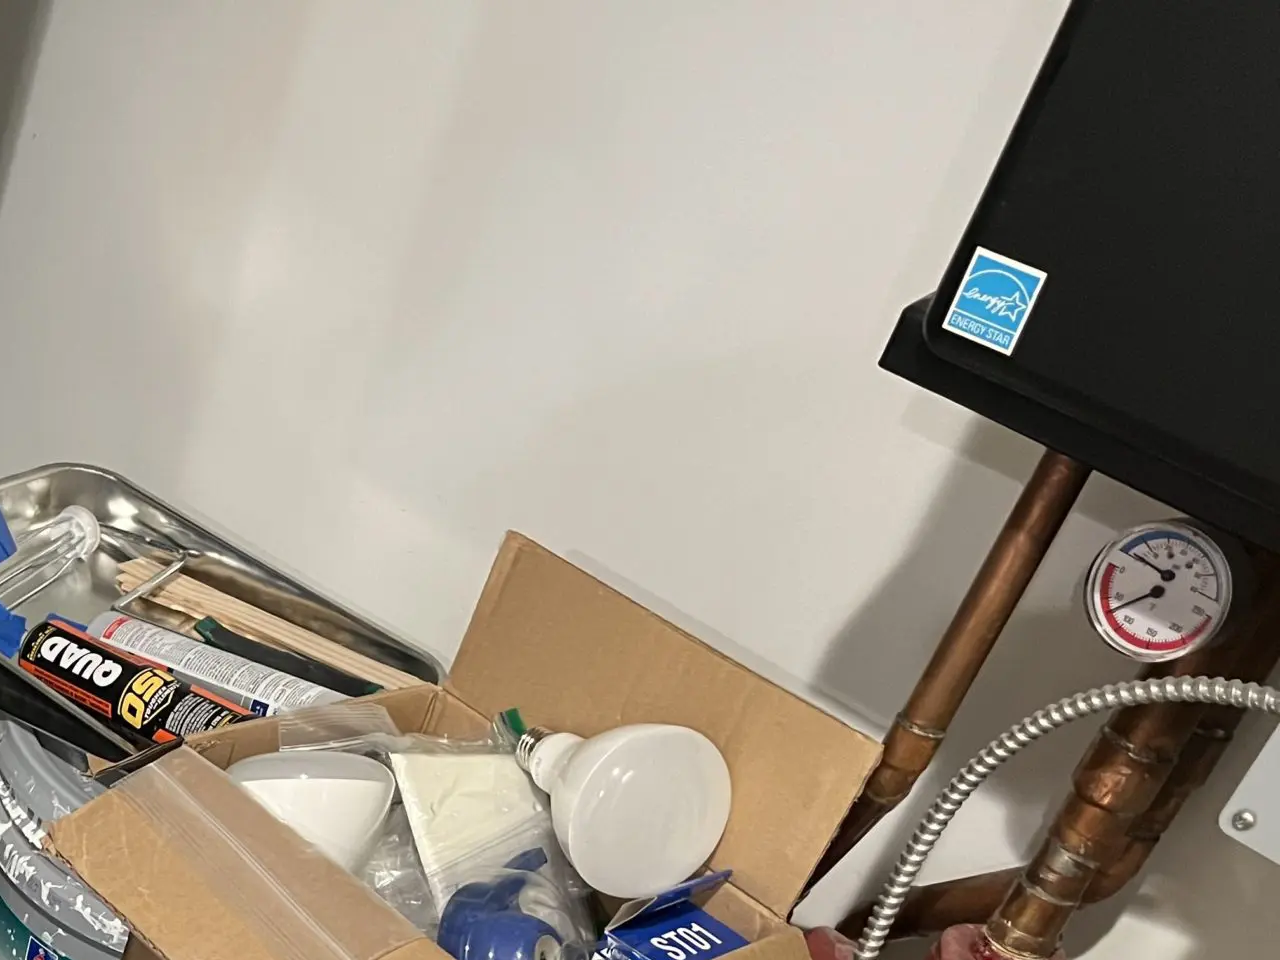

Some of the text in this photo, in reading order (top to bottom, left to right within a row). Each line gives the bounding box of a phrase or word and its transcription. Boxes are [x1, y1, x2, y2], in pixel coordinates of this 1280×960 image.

[950, 313, 1011, 346] ENERGY STAR
[1123, 614, 1135, 625] 100
[1146, 627, 1158, 638] 150
[40, 636, 123, 687] QUAD
